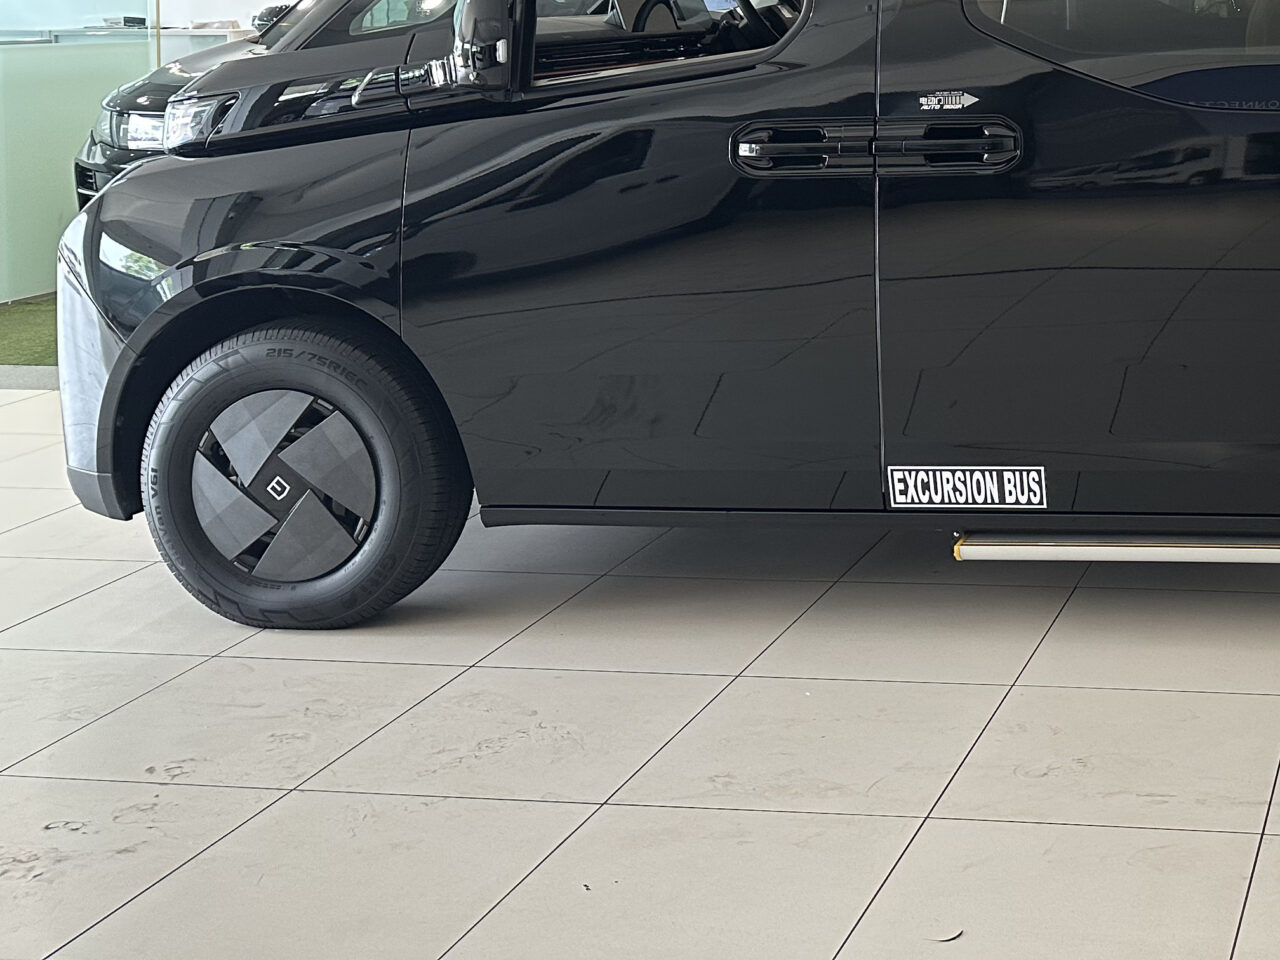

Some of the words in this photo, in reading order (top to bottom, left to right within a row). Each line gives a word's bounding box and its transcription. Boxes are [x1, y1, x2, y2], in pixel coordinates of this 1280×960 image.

[265, 347, 368, 389] 215/75R16C
[892, 470, 1000, 504] EXCURSION
[1002, 470, 1041, 505] BUS
